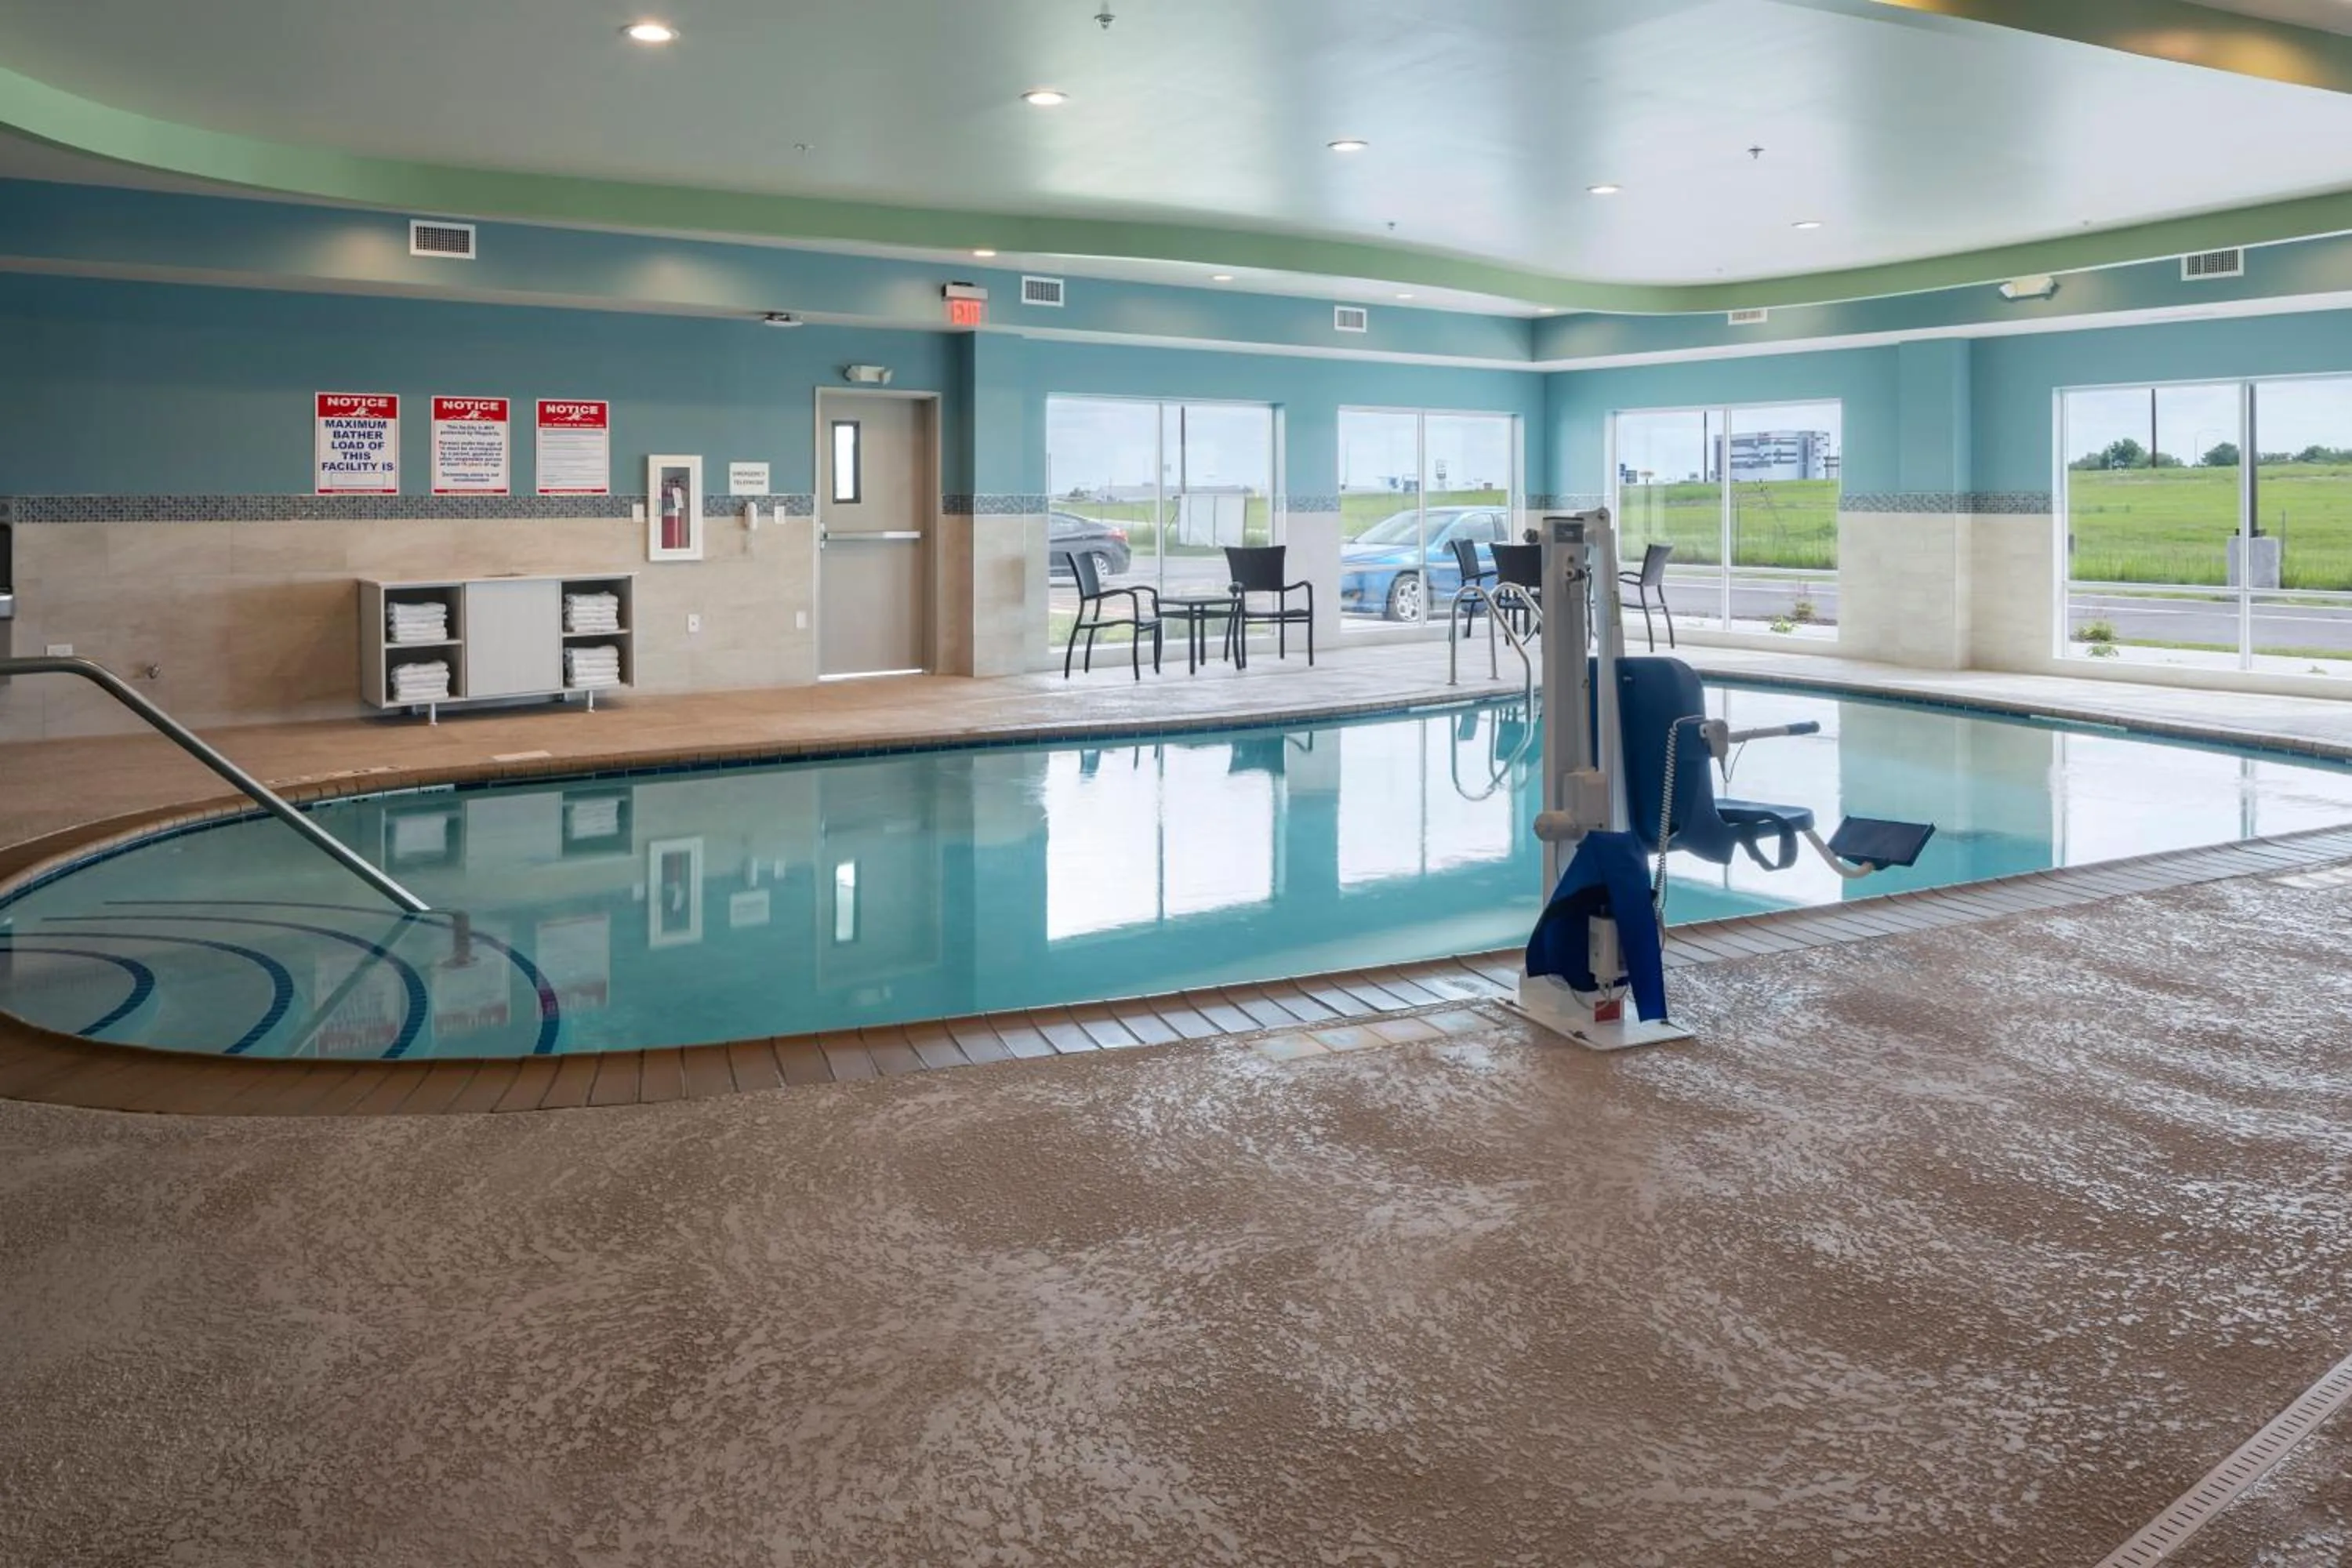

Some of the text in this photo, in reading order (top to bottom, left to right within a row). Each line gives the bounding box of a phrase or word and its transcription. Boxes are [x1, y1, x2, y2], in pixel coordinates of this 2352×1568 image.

[952, 300, 981, 325] EXIT
[327, 397, 389, 408] NOTICE
[442, 401, 499, 411] NOTICE
[546, 405, 599, 415] NOTICE
[325, 419, 387, 429] MAXIMUM
[333, 430, 383, 440] BATHER
[332, 441, 385, 450] LOAD OF
[342, 452, 372, 460] THIS
[321, 462, 394, 471] FACILITY IS
